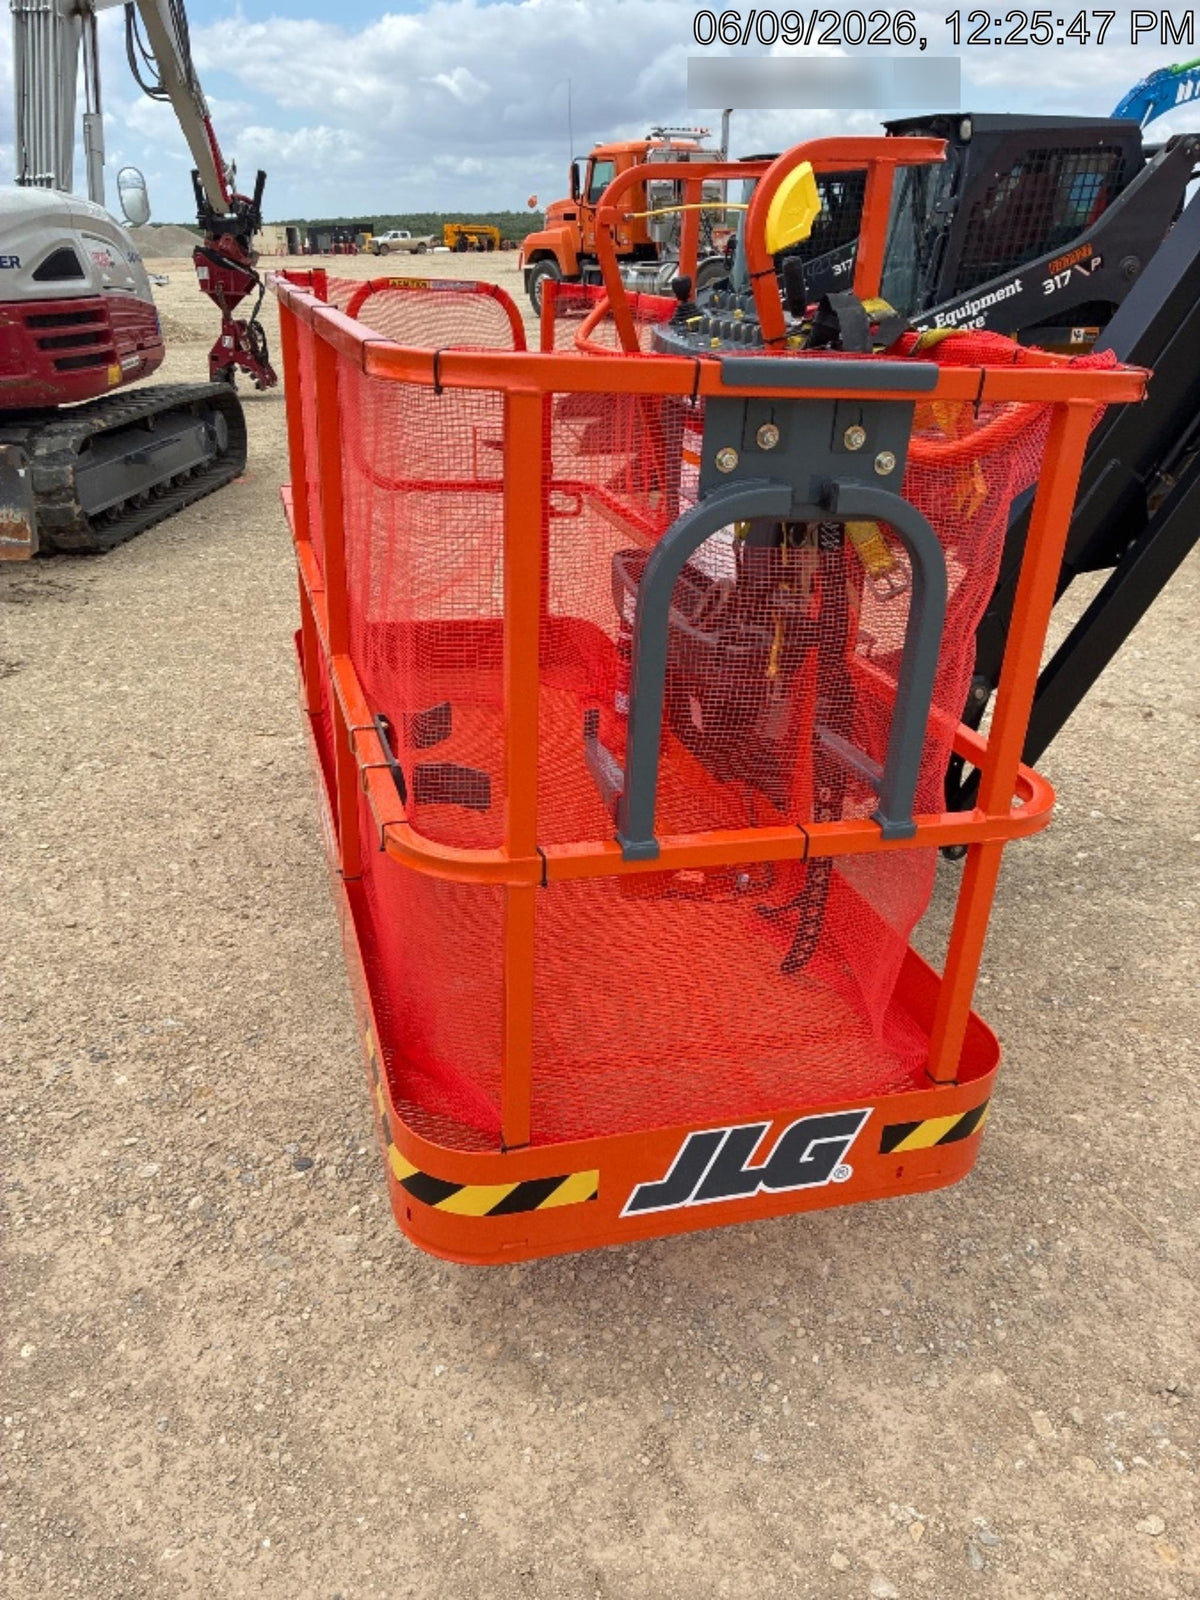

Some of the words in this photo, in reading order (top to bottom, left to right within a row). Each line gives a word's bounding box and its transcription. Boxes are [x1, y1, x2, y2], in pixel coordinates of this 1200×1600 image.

[934, 278, 1023, 329] Equipment
[1041, 269, 1071, 295] 317
[618, 1106, 875, 1218] JLG
